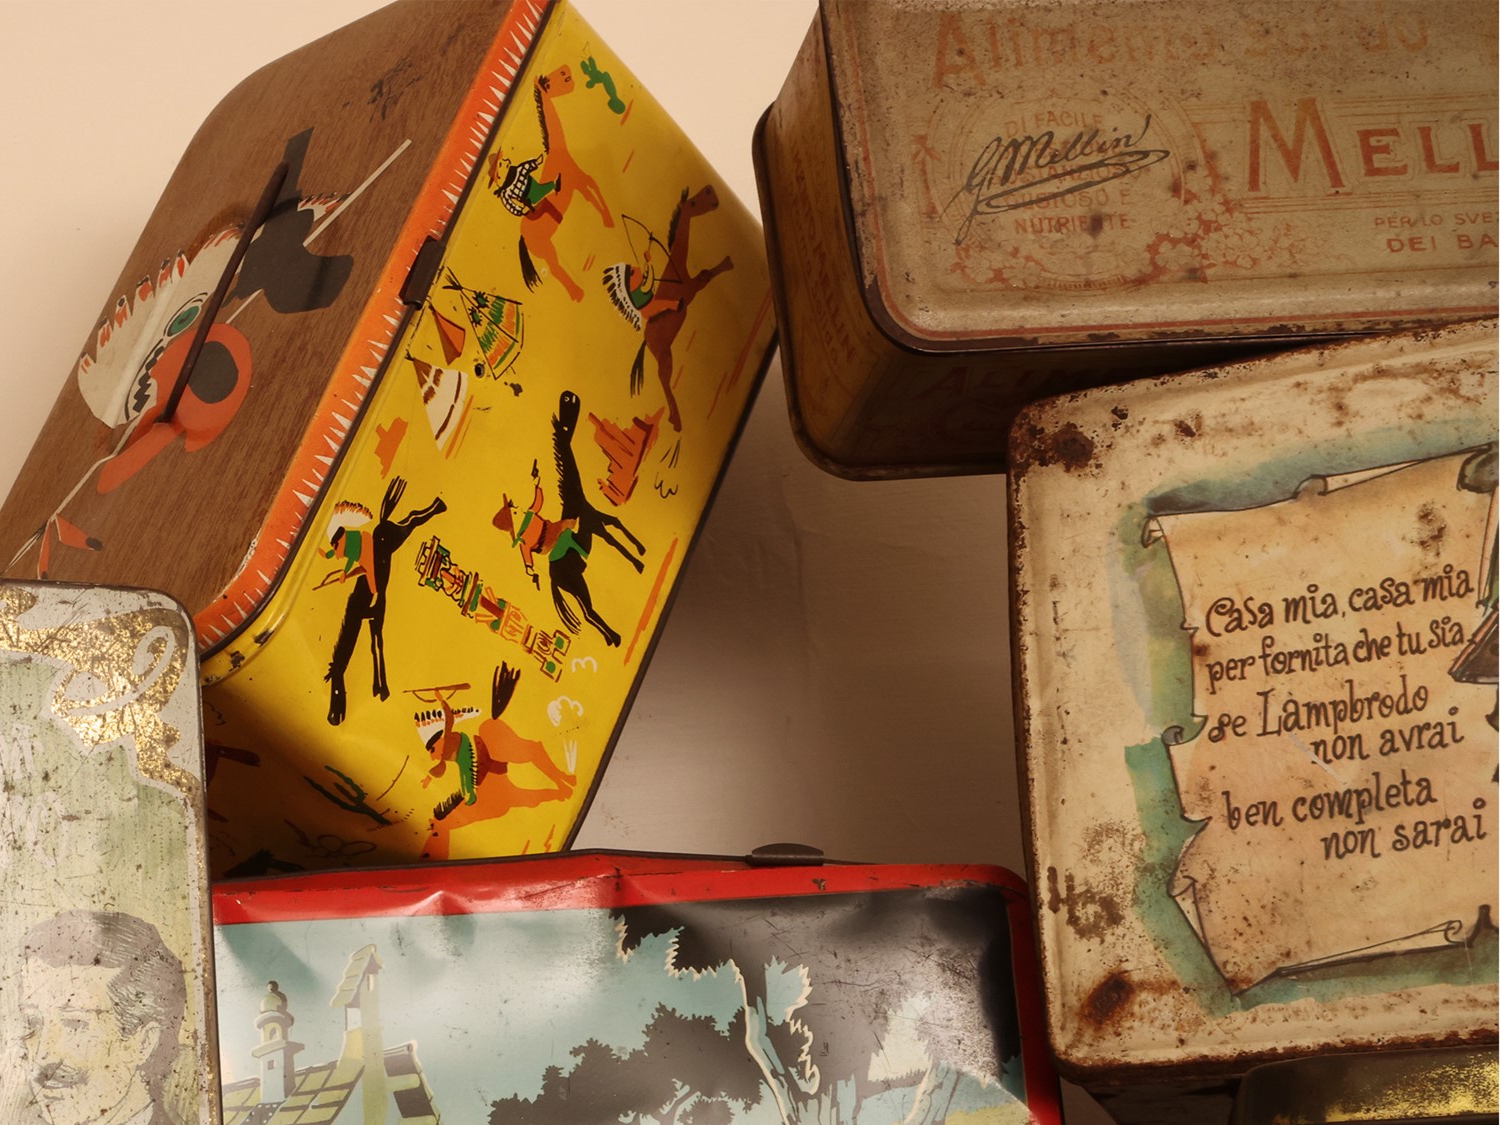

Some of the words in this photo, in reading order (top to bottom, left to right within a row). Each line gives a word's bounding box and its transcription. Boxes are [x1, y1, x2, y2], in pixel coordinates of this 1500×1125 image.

[1015, 213, 1132, 235] NUTRIETE
[1375, 215, 1413, 229] PER
[1422, 213, 1444, 227] LO
[1454, 211, 1498, 226] SVE
[1387, 235, 1437, 253] DEI
[1457, 233, 1498, 250] BA
[1206, 597, 1274, 637] Casa
[1348, 577, 1415, 612] casa
[1422, 563, 1474, 602] mia
[1206, 656, 1256, 695] per
[1258, 634, 1350, 676] fornita
[1352, 628, 1392, 663] che
[1396, 621, 1426, 656] tu
[1310, 735, 1371, 765] non
[1378, 706, 1465, 756] avrai
[1222, 790, 1284, 830] ben
[1292, 768, 1438, 825] completa
[1321, 826, 1382, 861] non
[1392, 798, 1487, 851] sarai
